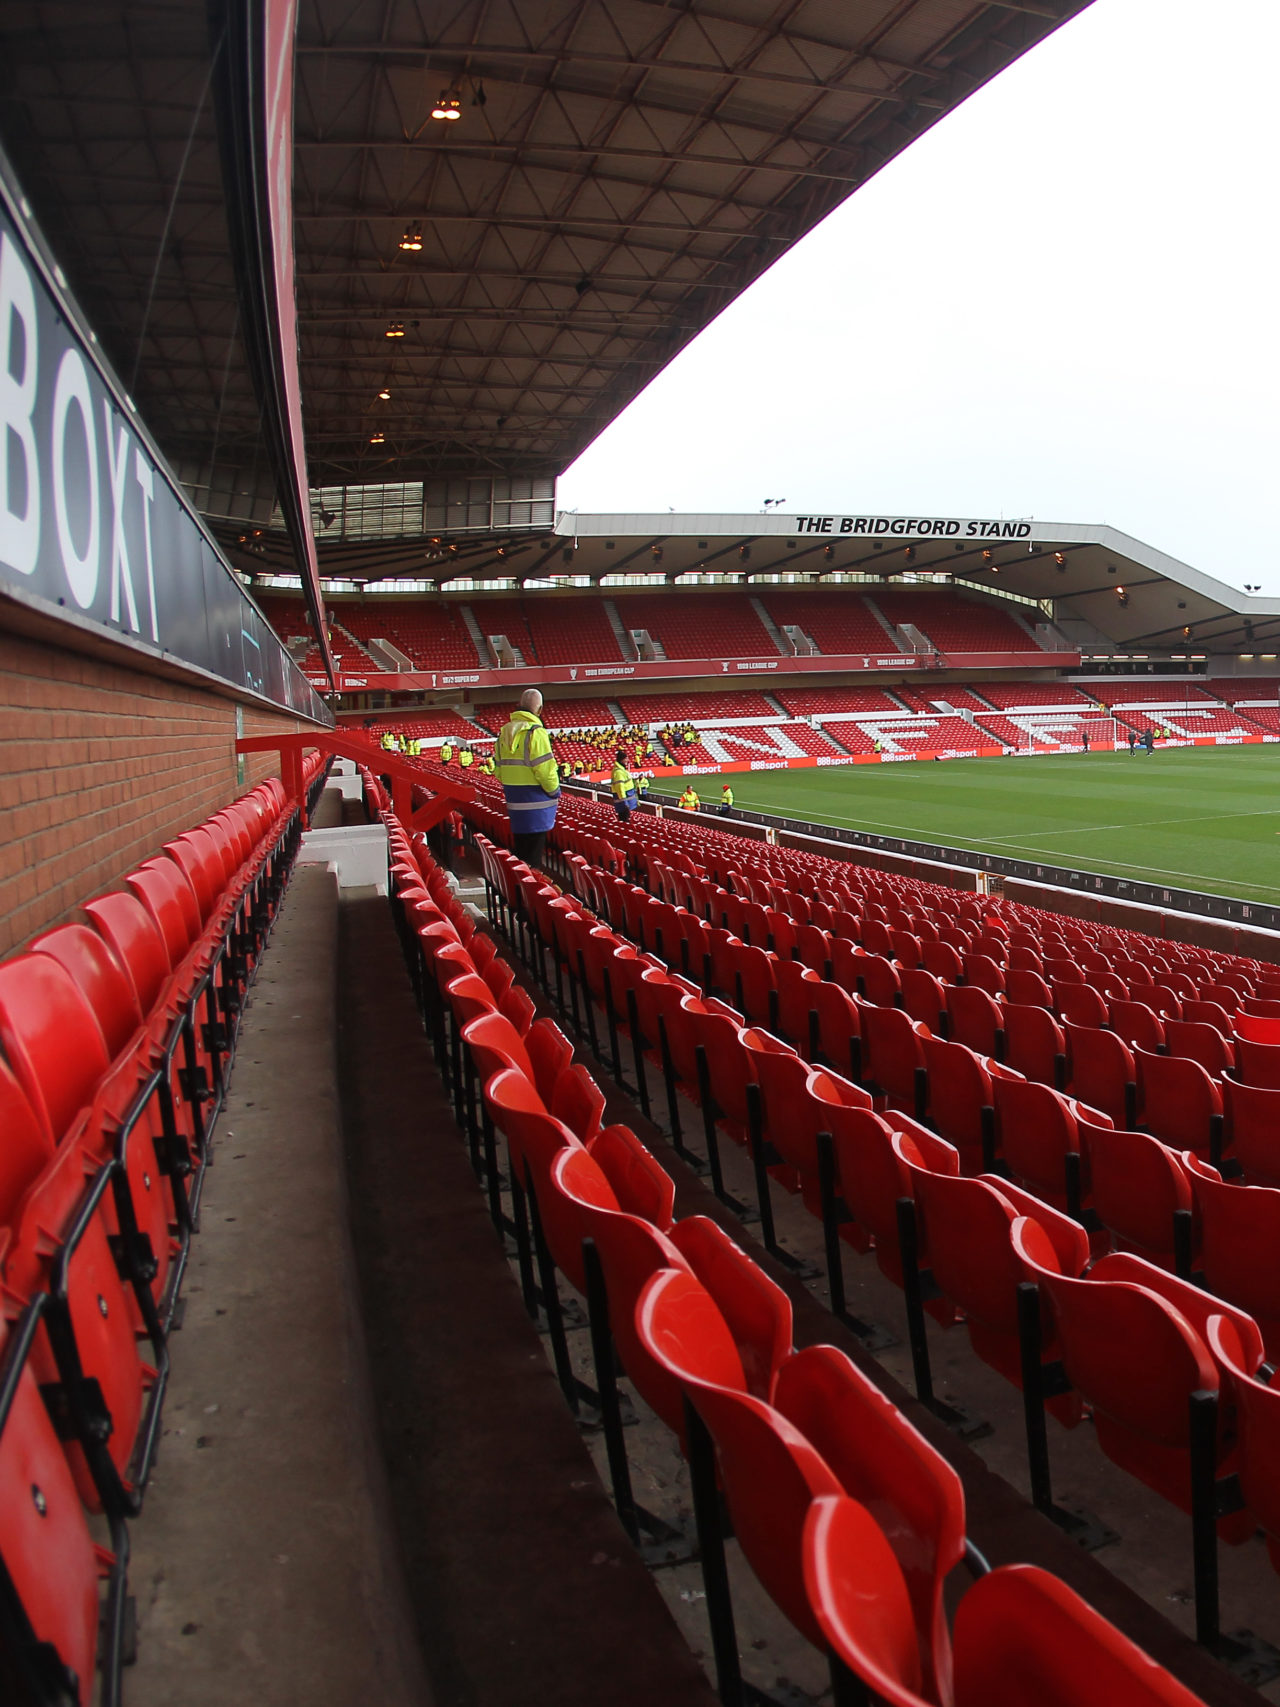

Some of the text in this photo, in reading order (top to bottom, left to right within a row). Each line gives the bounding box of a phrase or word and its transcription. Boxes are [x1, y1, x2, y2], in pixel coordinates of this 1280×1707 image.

[0, 230, 160, 643] BOXT
[796, 517, 1031, 538] THE BRIDGFORD STAND
[1215, 736, 1243, 745] 888sport
[816, 756, 854, 766] 888sport
[881, 751, 917, 763] 888sport
[682, 764, 721, 775] 888sport
[750, 760, 789, 770] 888sport
